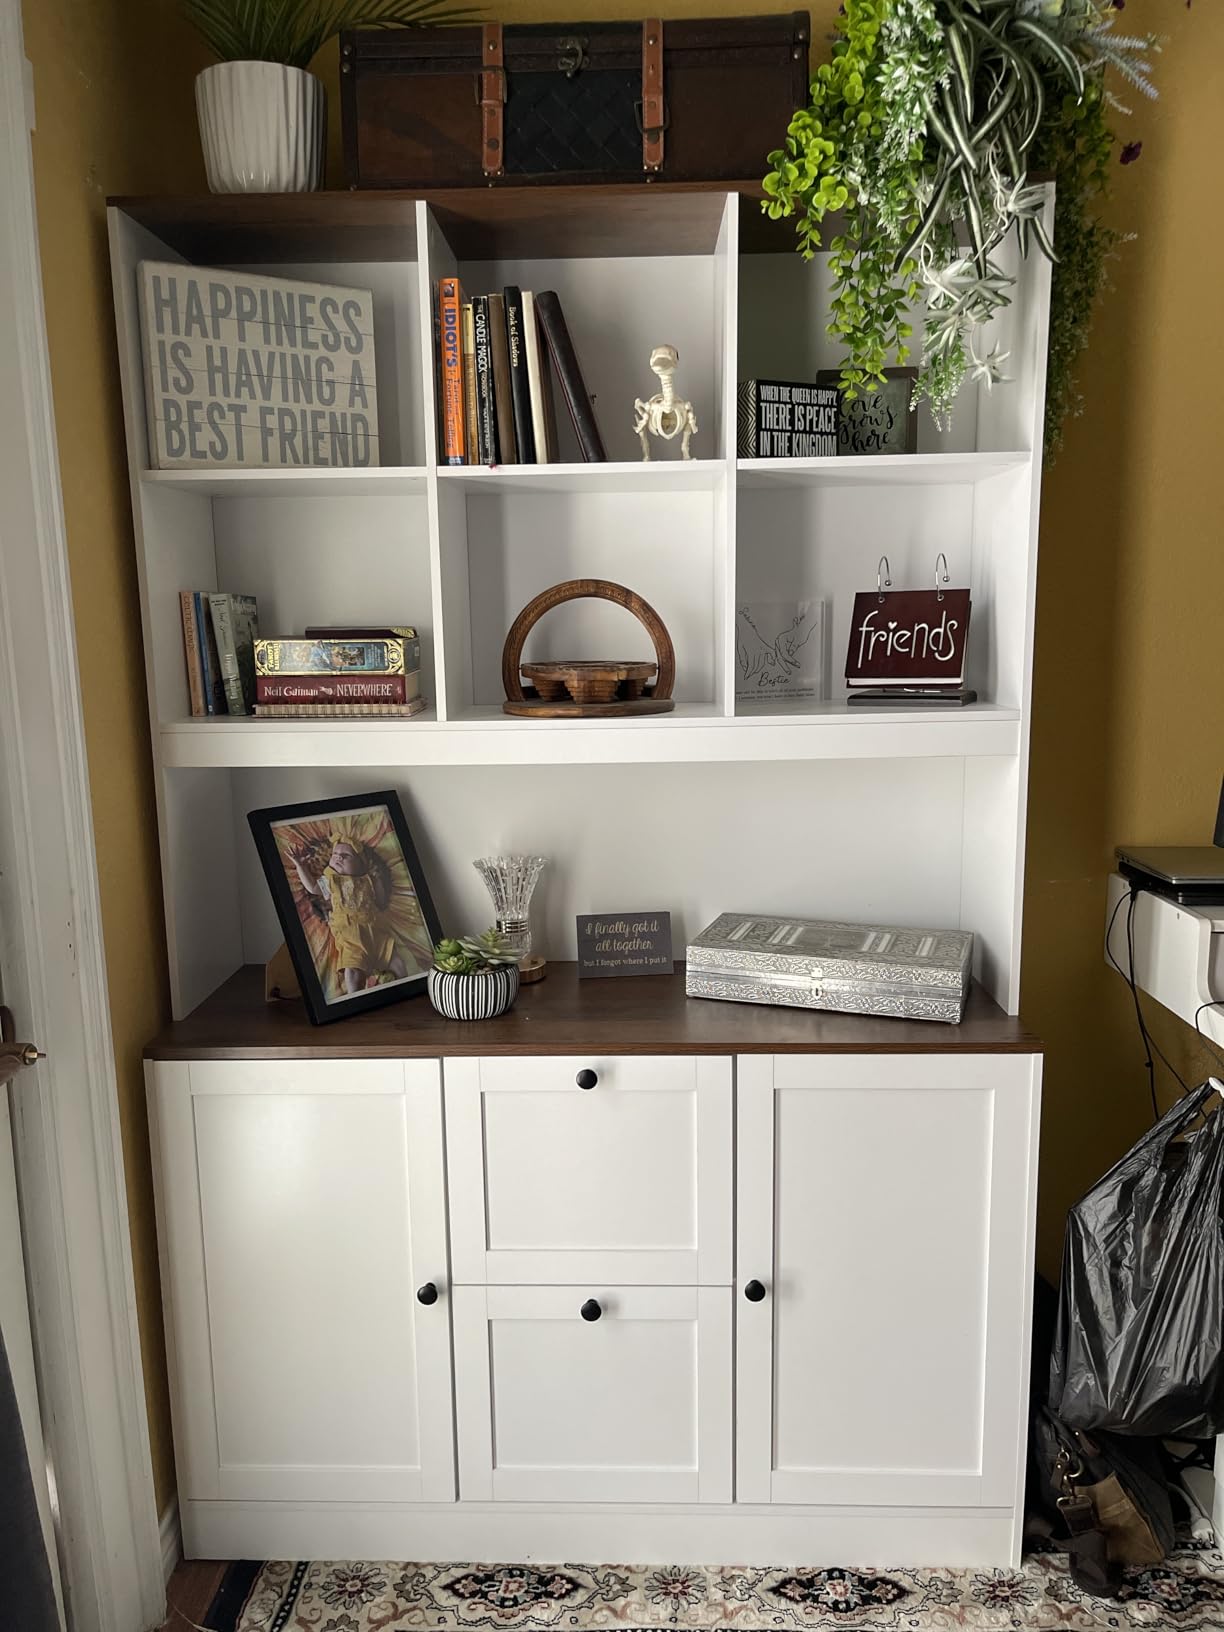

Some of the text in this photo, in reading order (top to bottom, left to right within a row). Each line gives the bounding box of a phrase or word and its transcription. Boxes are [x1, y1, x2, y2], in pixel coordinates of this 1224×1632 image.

[152, 275, 363, 355] HAPPINESS
[475, 314, 486, 343] CANDLE
[444, 308, 457, 368] IDIOT'S
[509, 306, 520, 368] Book of Shadows
[477, 345, 488, 373] MAGICK
[157, 339, 368, 409] IS HAVING A
[760, 384, 779, 402] WHEN
[779, 386, 791, 402] THE
[791, 387, 811, 404] QUEEN
[811, 389, 818, 404] IS
[760, 402, 837, 433] THERE IS PEACE
[162, 398, 371, 467] BEST FRIEND
[760, 430, 837, 457] IN THE KINGDOM
[850, 429, 889, 452] here
[858, 610, 958, 669] friends
[264, 683, 393, 698] Neil Gaiman NEVERWHERE
[758, 671, 792, 687] Bestie
[594, 922, 629, 939] finally
[632, 920, 649, 937] got
[650, 919, 659, 932] it
[595, 937, 653, 955] all together
